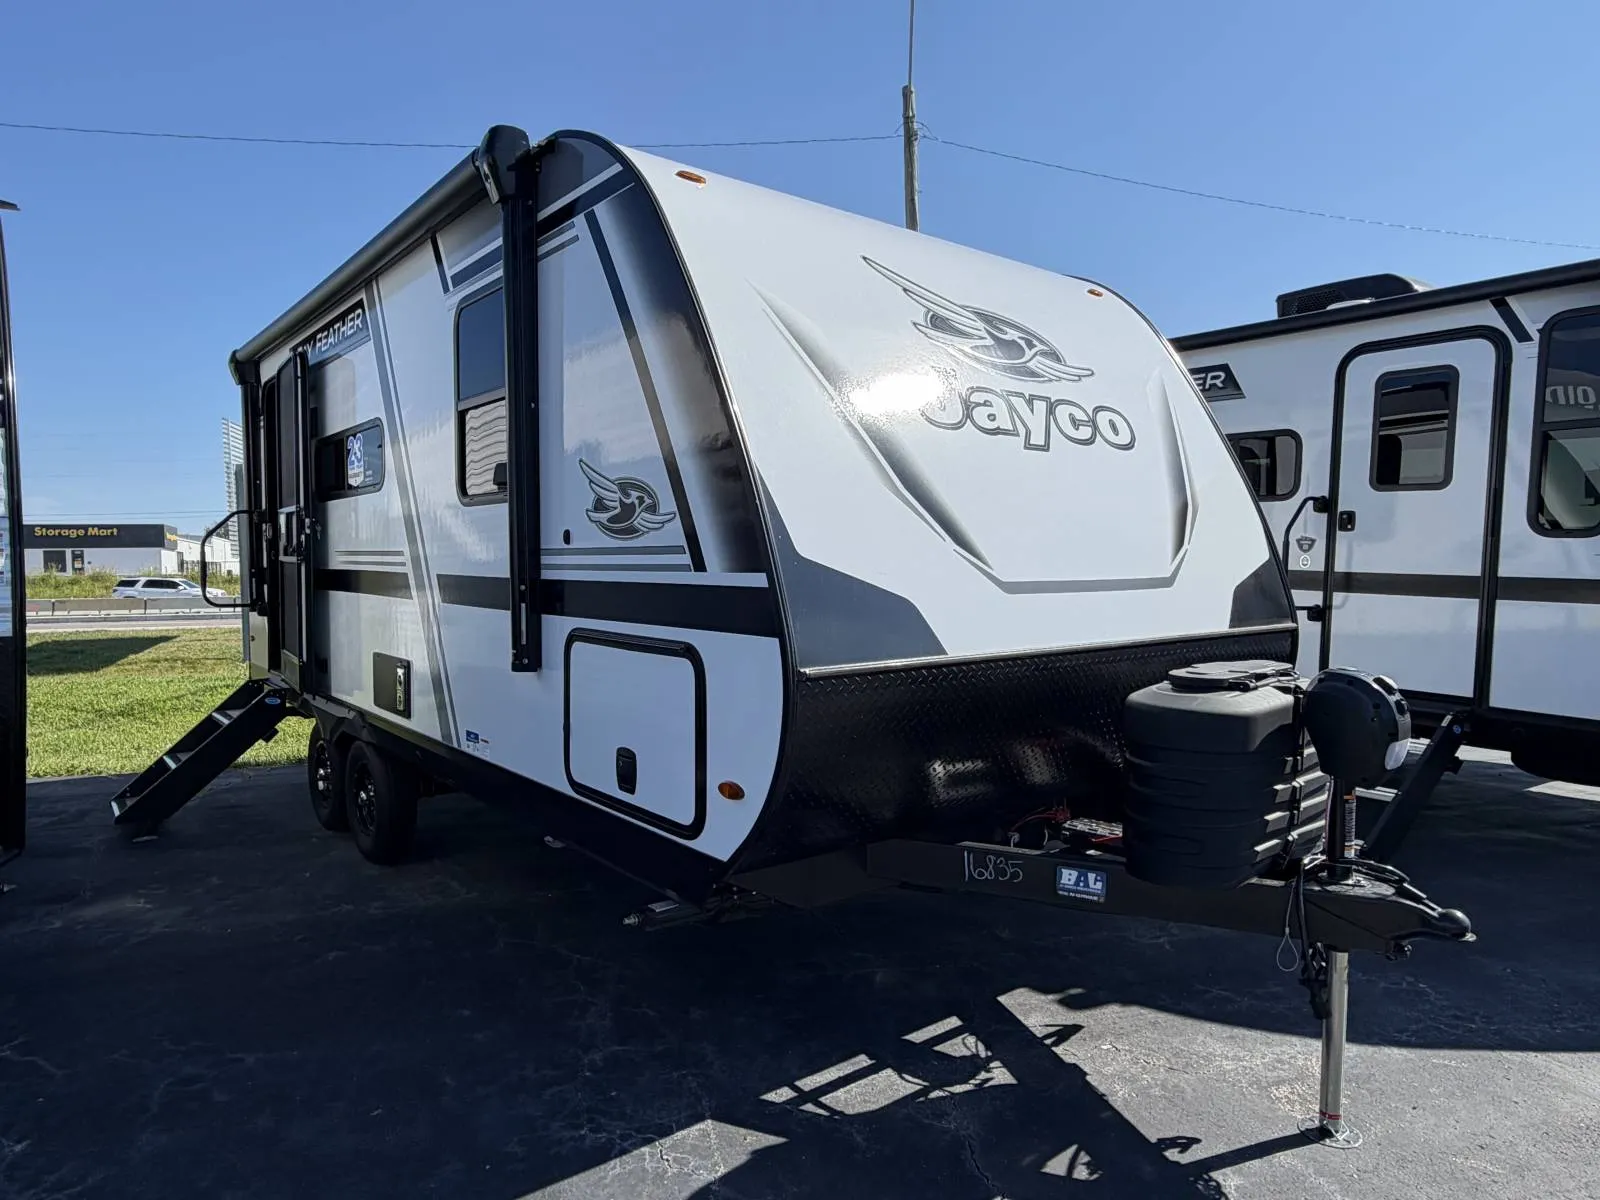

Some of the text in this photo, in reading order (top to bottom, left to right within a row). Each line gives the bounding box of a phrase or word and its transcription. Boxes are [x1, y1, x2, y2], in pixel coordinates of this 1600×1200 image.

[315, 308, 363, 354] FEATHER
[918, 366, 1136, 452] Jayco
[34, 526, 118, 538] Storage Mart
[964, 850, 1024, 882] 16835
[1060, 868, 1103, 889] BAL
